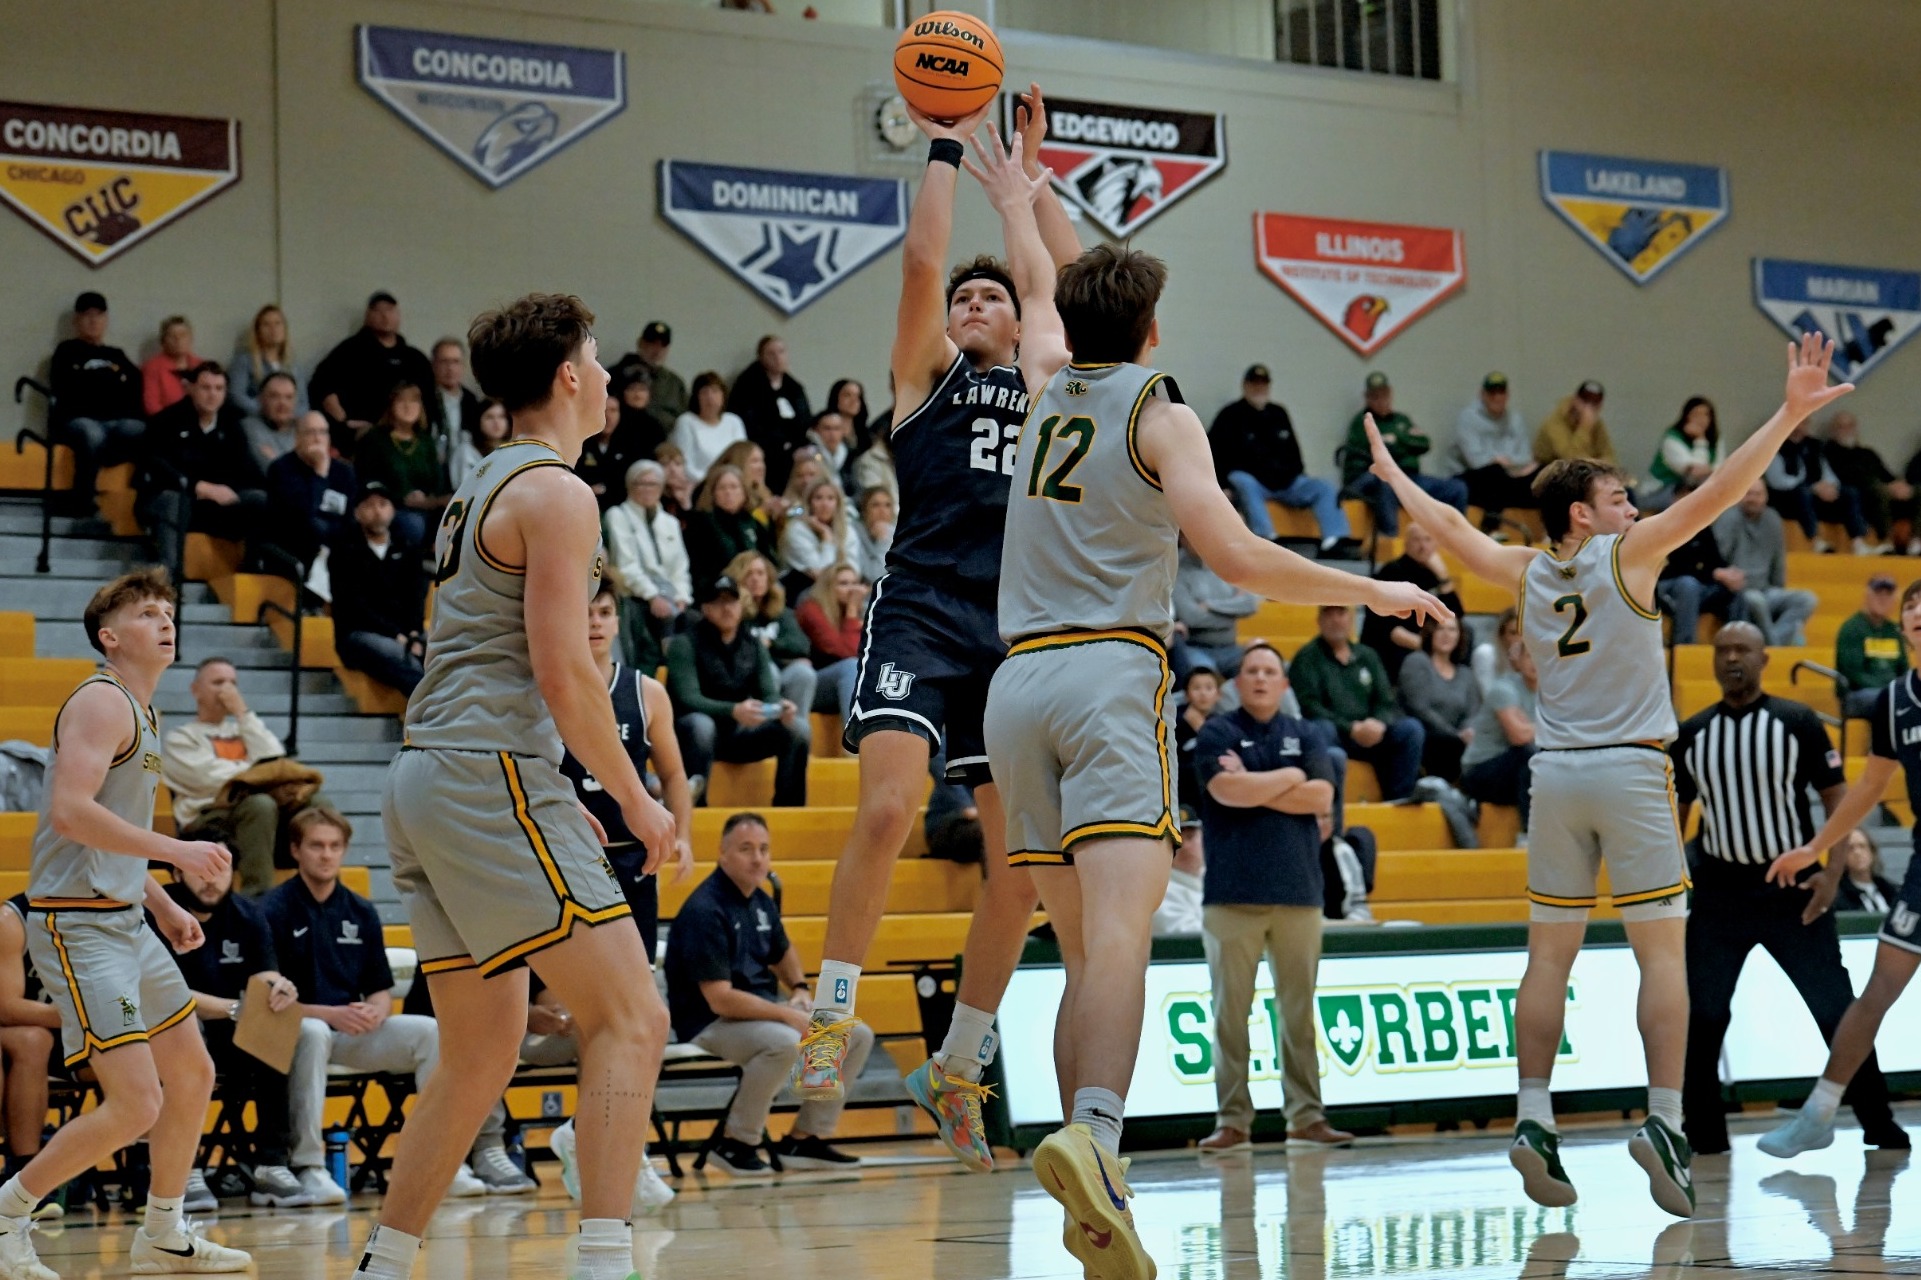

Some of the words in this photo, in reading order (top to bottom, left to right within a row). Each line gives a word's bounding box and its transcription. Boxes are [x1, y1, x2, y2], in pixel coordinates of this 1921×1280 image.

[914, 21, 984, 50] Wilson
[412, 47, 574, 89] CONCORDIA
[915, 53, 969, 77] NCAA
[3, 119, 182, 161] CONCORDIA
[1051, 111, 1180, 150] EDGEWOOD
[7, 165, 86, 185] CHICAGO
[1585, 168, 1687, 199] LAKELAND
[712, 179, 860, 217] DOMINICAN
[1315, 232, 1405, 262] ILLINOIS
[1806, 276, 1879, 305] MARIAN
[952, 384, 1030, 414] LAWREN
[970, 417, 1023, 476] 22
[1027, 414, 1097, 504] 12
[1553, 593, 1591, 658] 2
[875, 662, 916, 700] LU
[1890, 900, 1920, 937] LU
